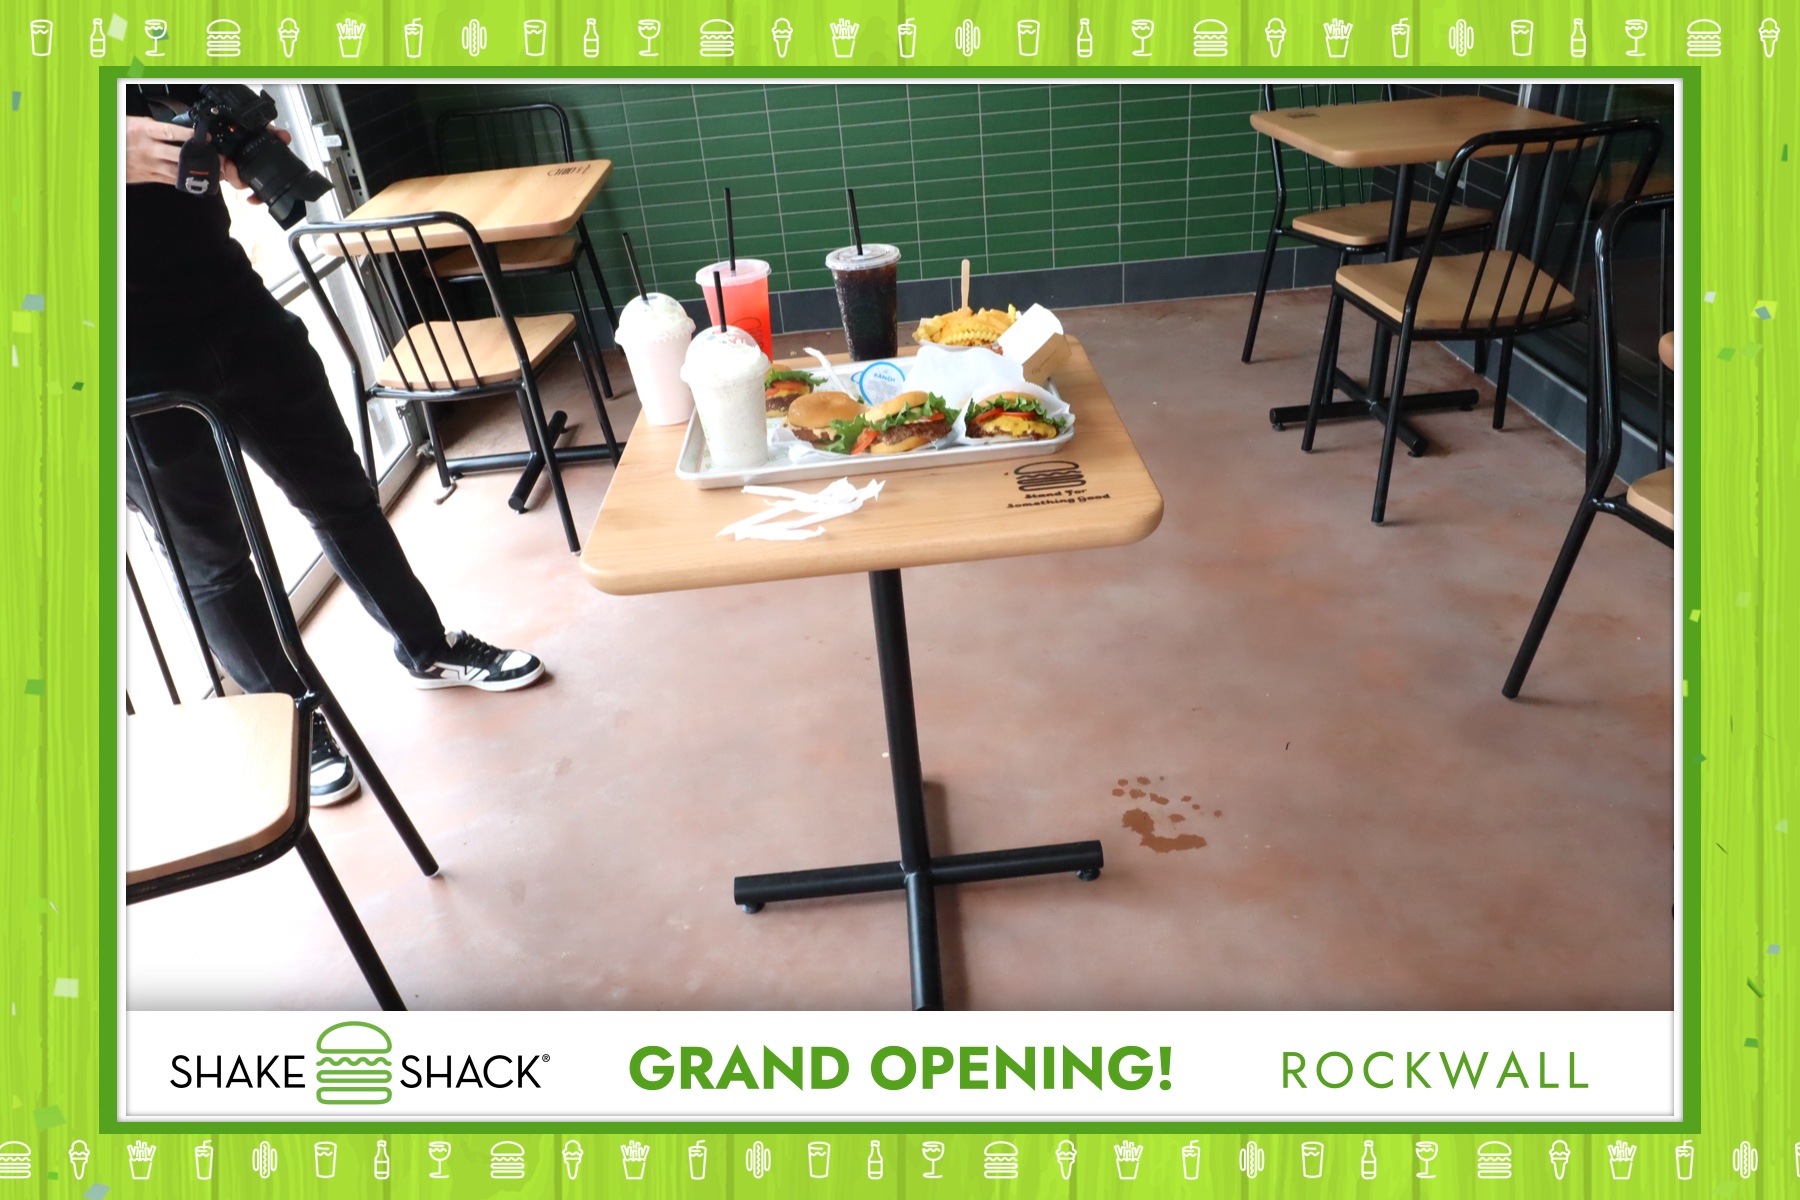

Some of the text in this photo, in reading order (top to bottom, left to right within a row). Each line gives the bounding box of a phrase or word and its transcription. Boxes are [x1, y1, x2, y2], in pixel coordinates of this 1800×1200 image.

[873, 372, 896, 383] RANCH
[1024, 490, 1063, 499] Stand
[1006, 493, 1111, 509] Something Good
